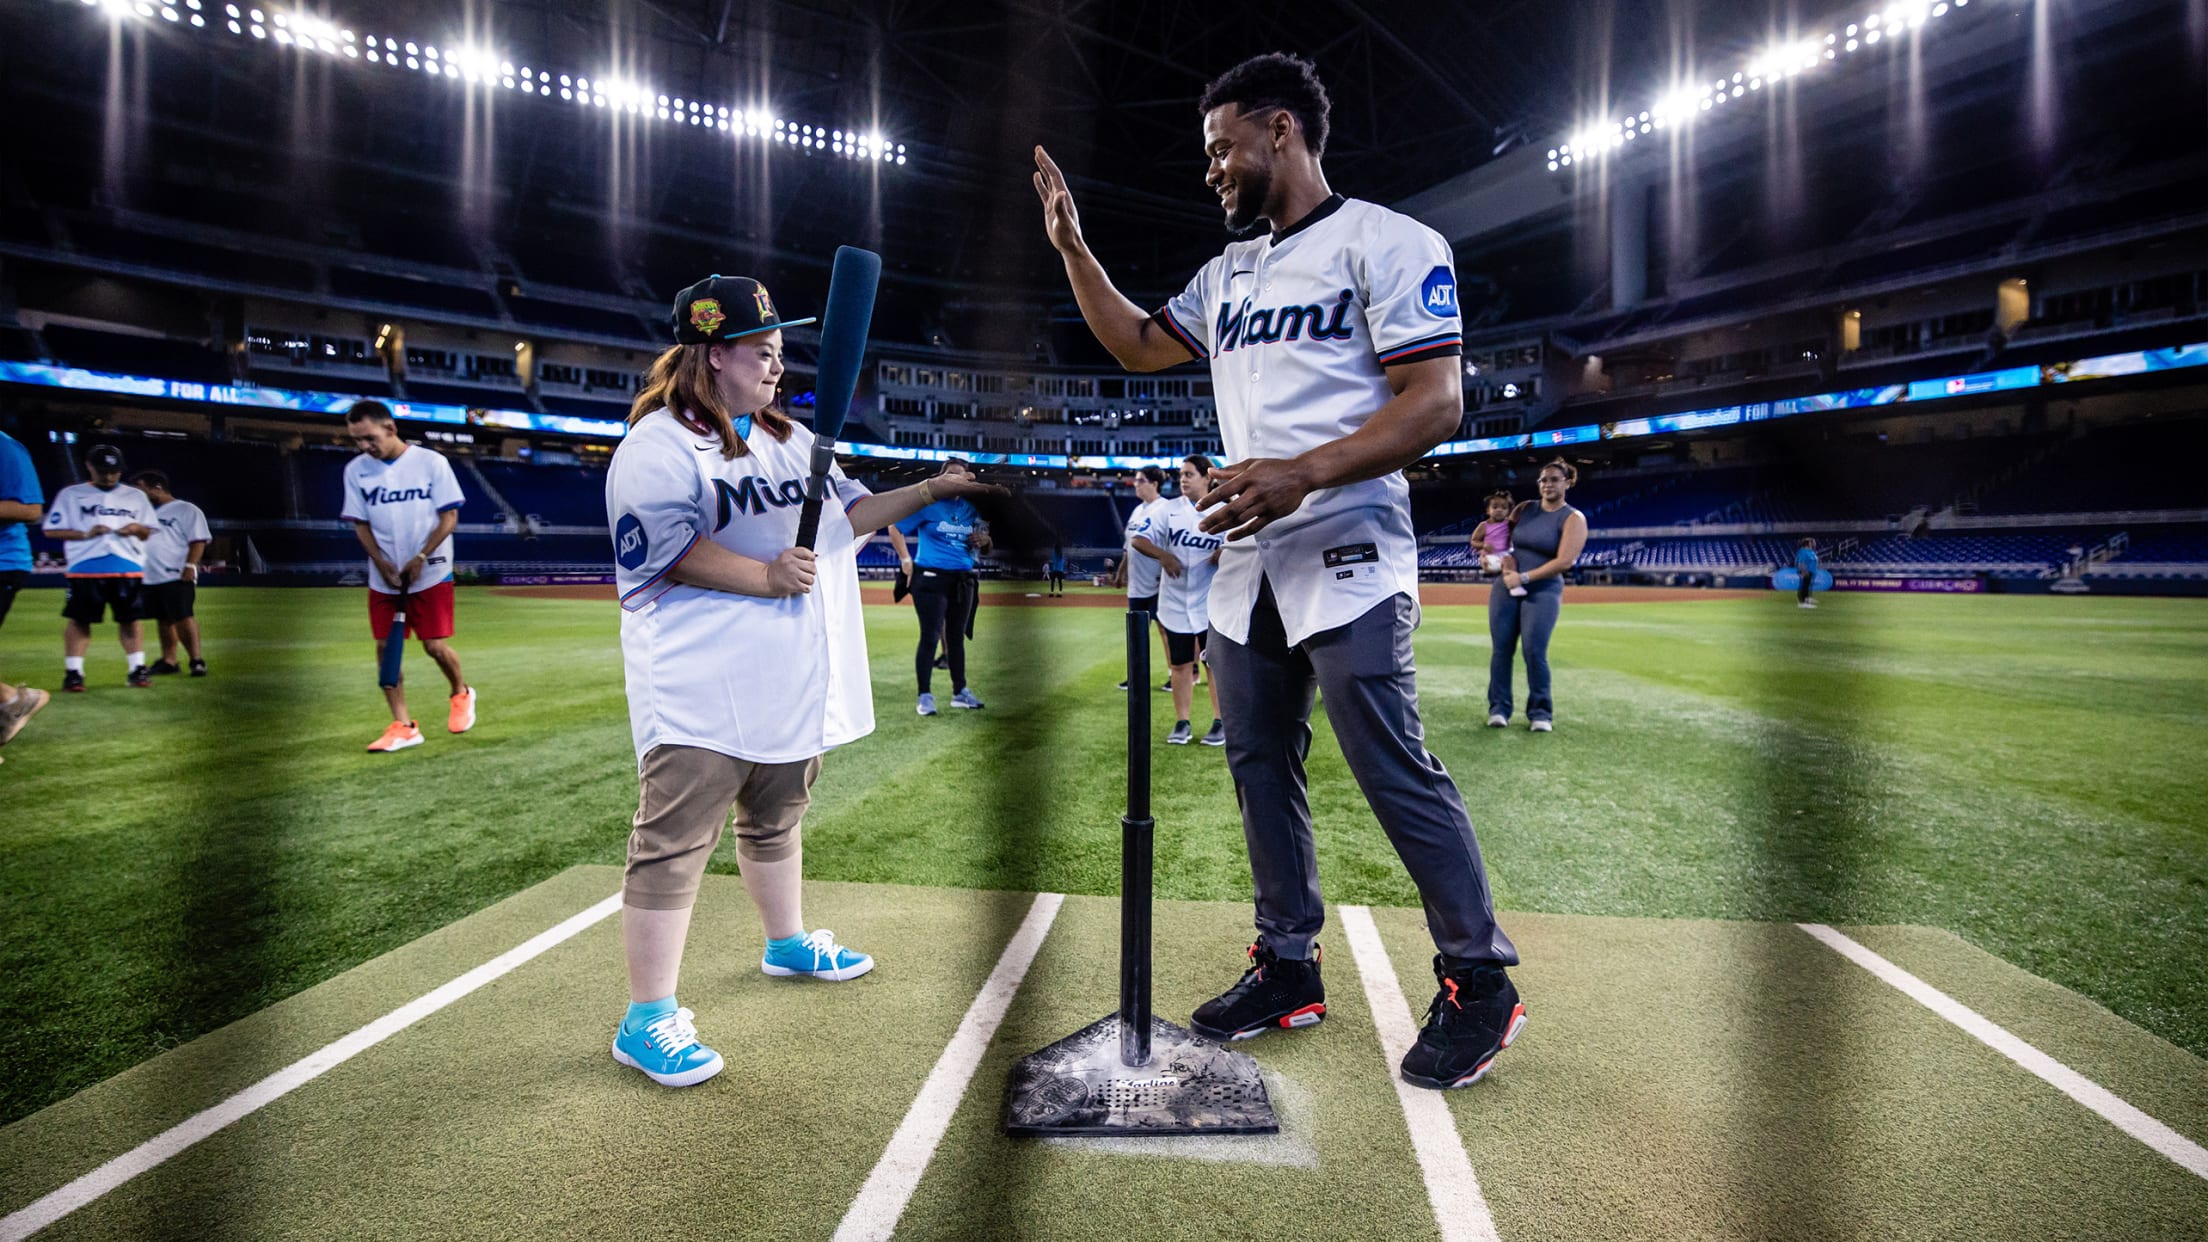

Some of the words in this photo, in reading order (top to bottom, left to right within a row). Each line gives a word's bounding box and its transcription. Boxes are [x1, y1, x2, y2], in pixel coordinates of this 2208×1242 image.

[1428, 284, 1453, 307] ADT
[1213, 287, 1354, 359] Miami
[170, 381, 205, 400] FOR
[209, 386, 240, 403] ALL
[1745, 402, 1769, 422] FOR
[360, 482, 434, 507] Miami
[80, 503, 137, 521] Miami
[619, 525, 642, 559] ADT
[1168, 527, 1225, 551] Miam
